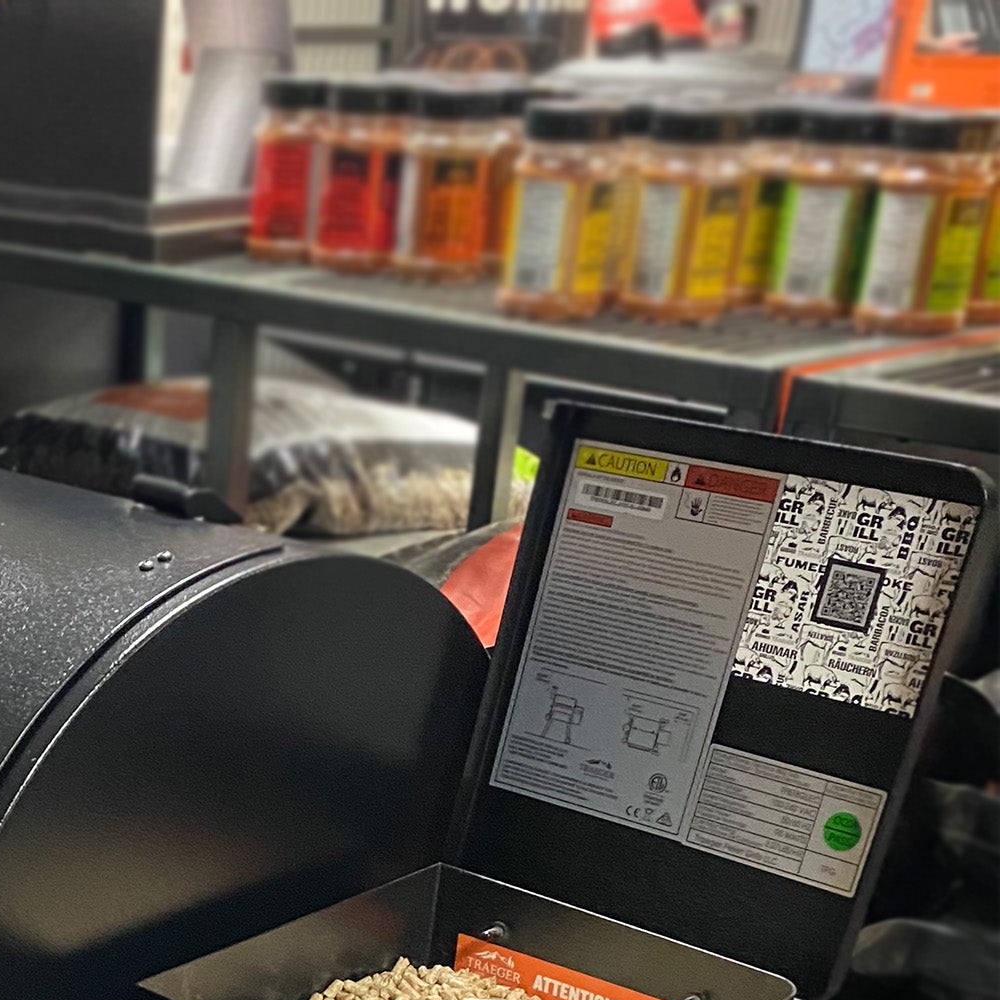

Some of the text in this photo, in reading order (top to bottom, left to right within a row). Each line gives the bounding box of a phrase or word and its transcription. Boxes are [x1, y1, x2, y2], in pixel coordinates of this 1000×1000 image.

[598, 453, 658, 476] CAUTION
[817, 497, 838, 545] BARBECUE
[857, 512, 884, 529] GR
[897, 516, 920, 560] BBQ
[791, 591, 810, 633] ASAR
[868, 605, 890, 652] BARBACOA
[751, 641, 798, 660] AHUMAR
[828, 658, 878, 678] RÄUCHERN
[467, 956, 521, 984] TRAEGER
